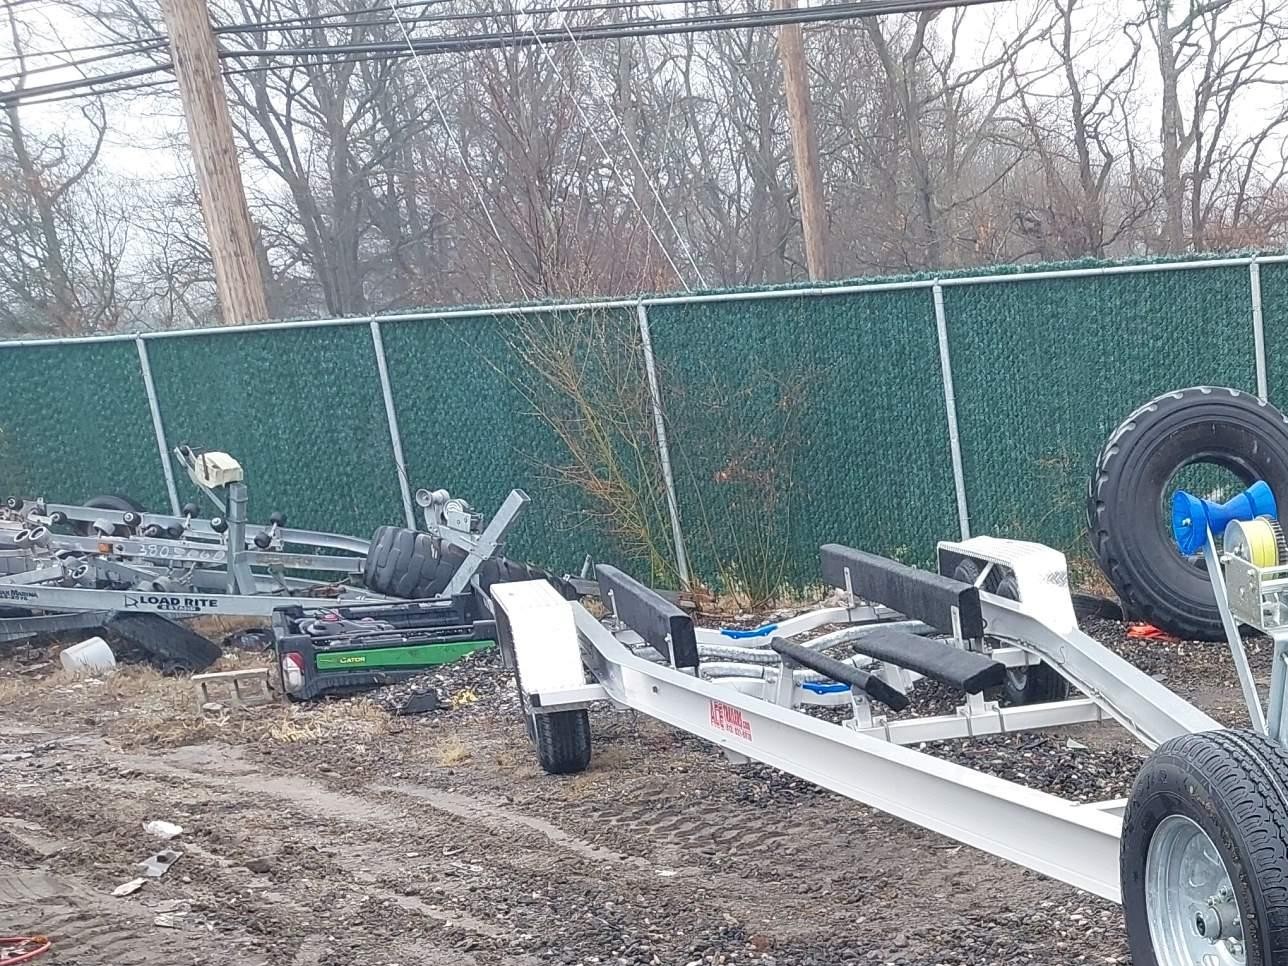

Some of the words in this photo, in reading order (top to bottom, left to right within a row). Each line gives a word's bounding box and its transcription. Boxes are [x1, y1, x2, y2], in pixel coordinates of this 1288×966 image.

[140, 596, 181, 606] LOAD
[185, 598, 218, 607] RITE
[340, 656, 366, 664] GATOR
